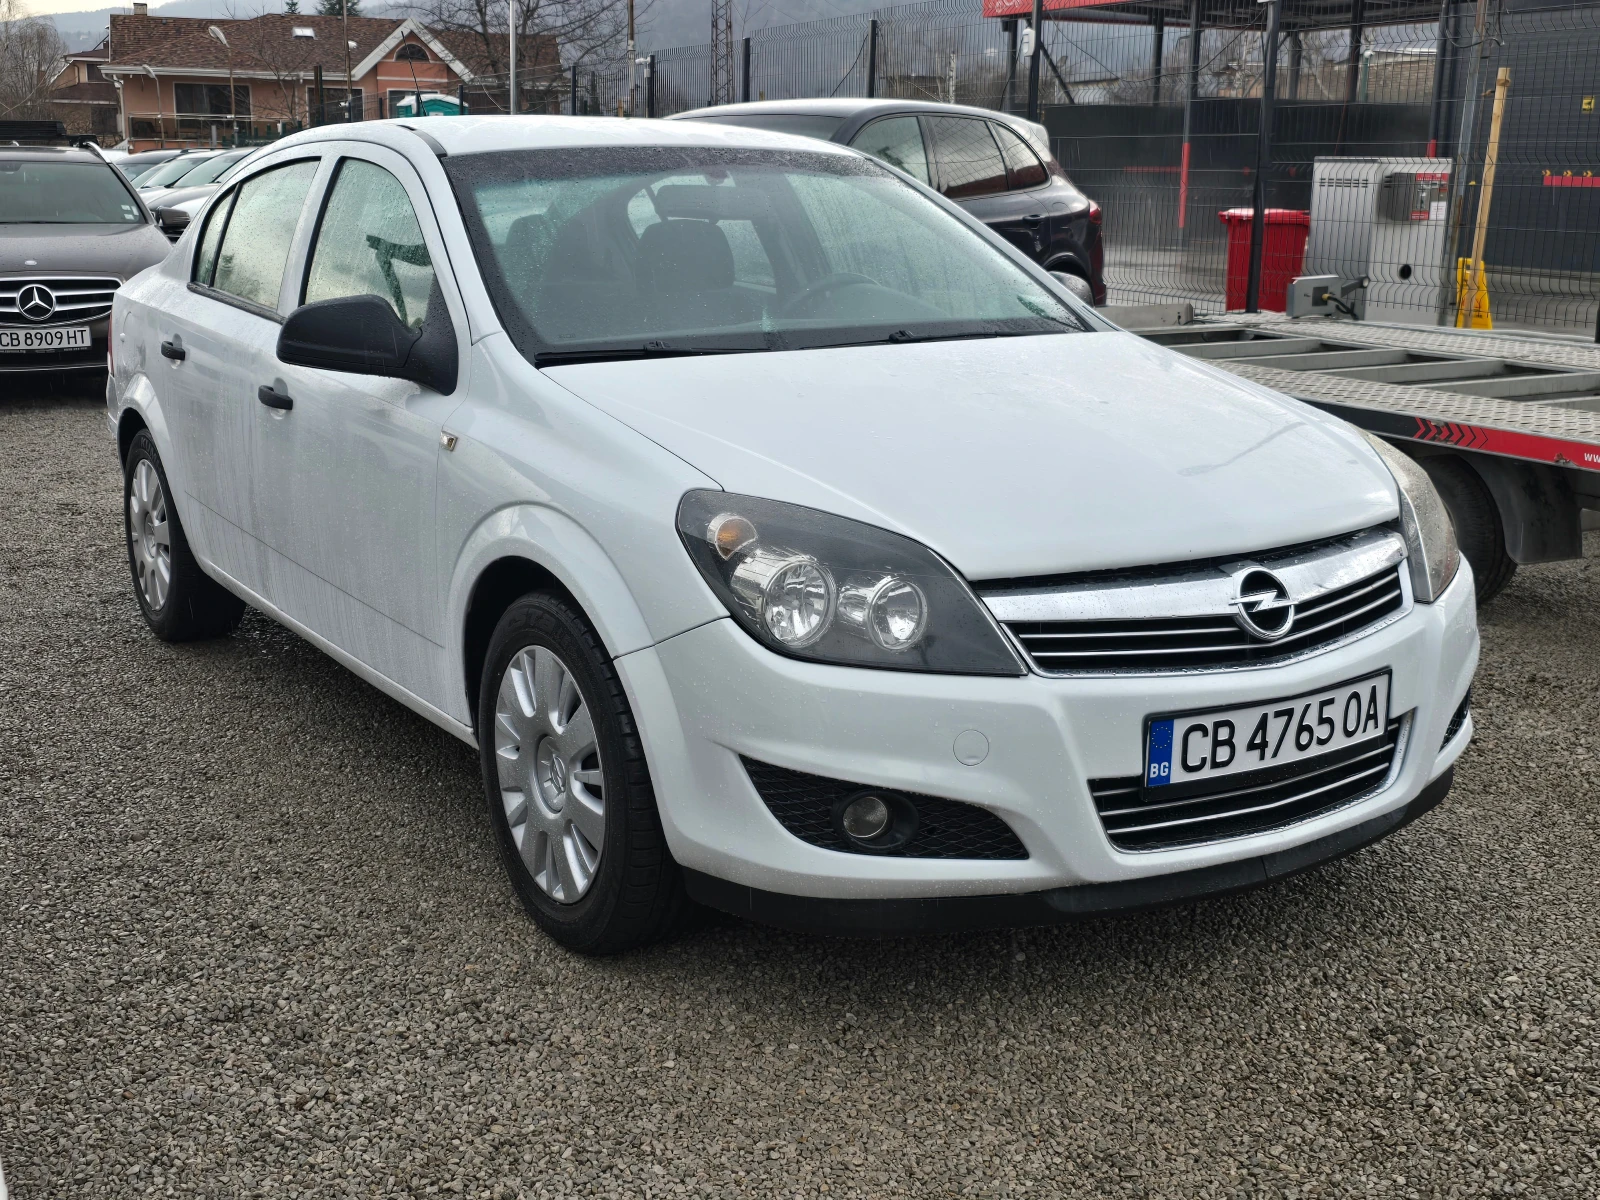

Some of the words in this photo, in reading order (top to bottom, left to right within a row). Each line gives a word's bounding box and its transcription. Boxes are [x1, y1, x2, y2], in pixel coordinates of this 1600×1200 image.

[0, 332, 20, 347] CB
[24, 331, 63, 347] 8909
[66, 329, 87, 345] HT
[1181, 719, 1236, 773] CB
[1246, 697, 1336, 761] 4765
[1342, 684, 1380, 738] OA
[1150, 761, 1169, 779] BG
